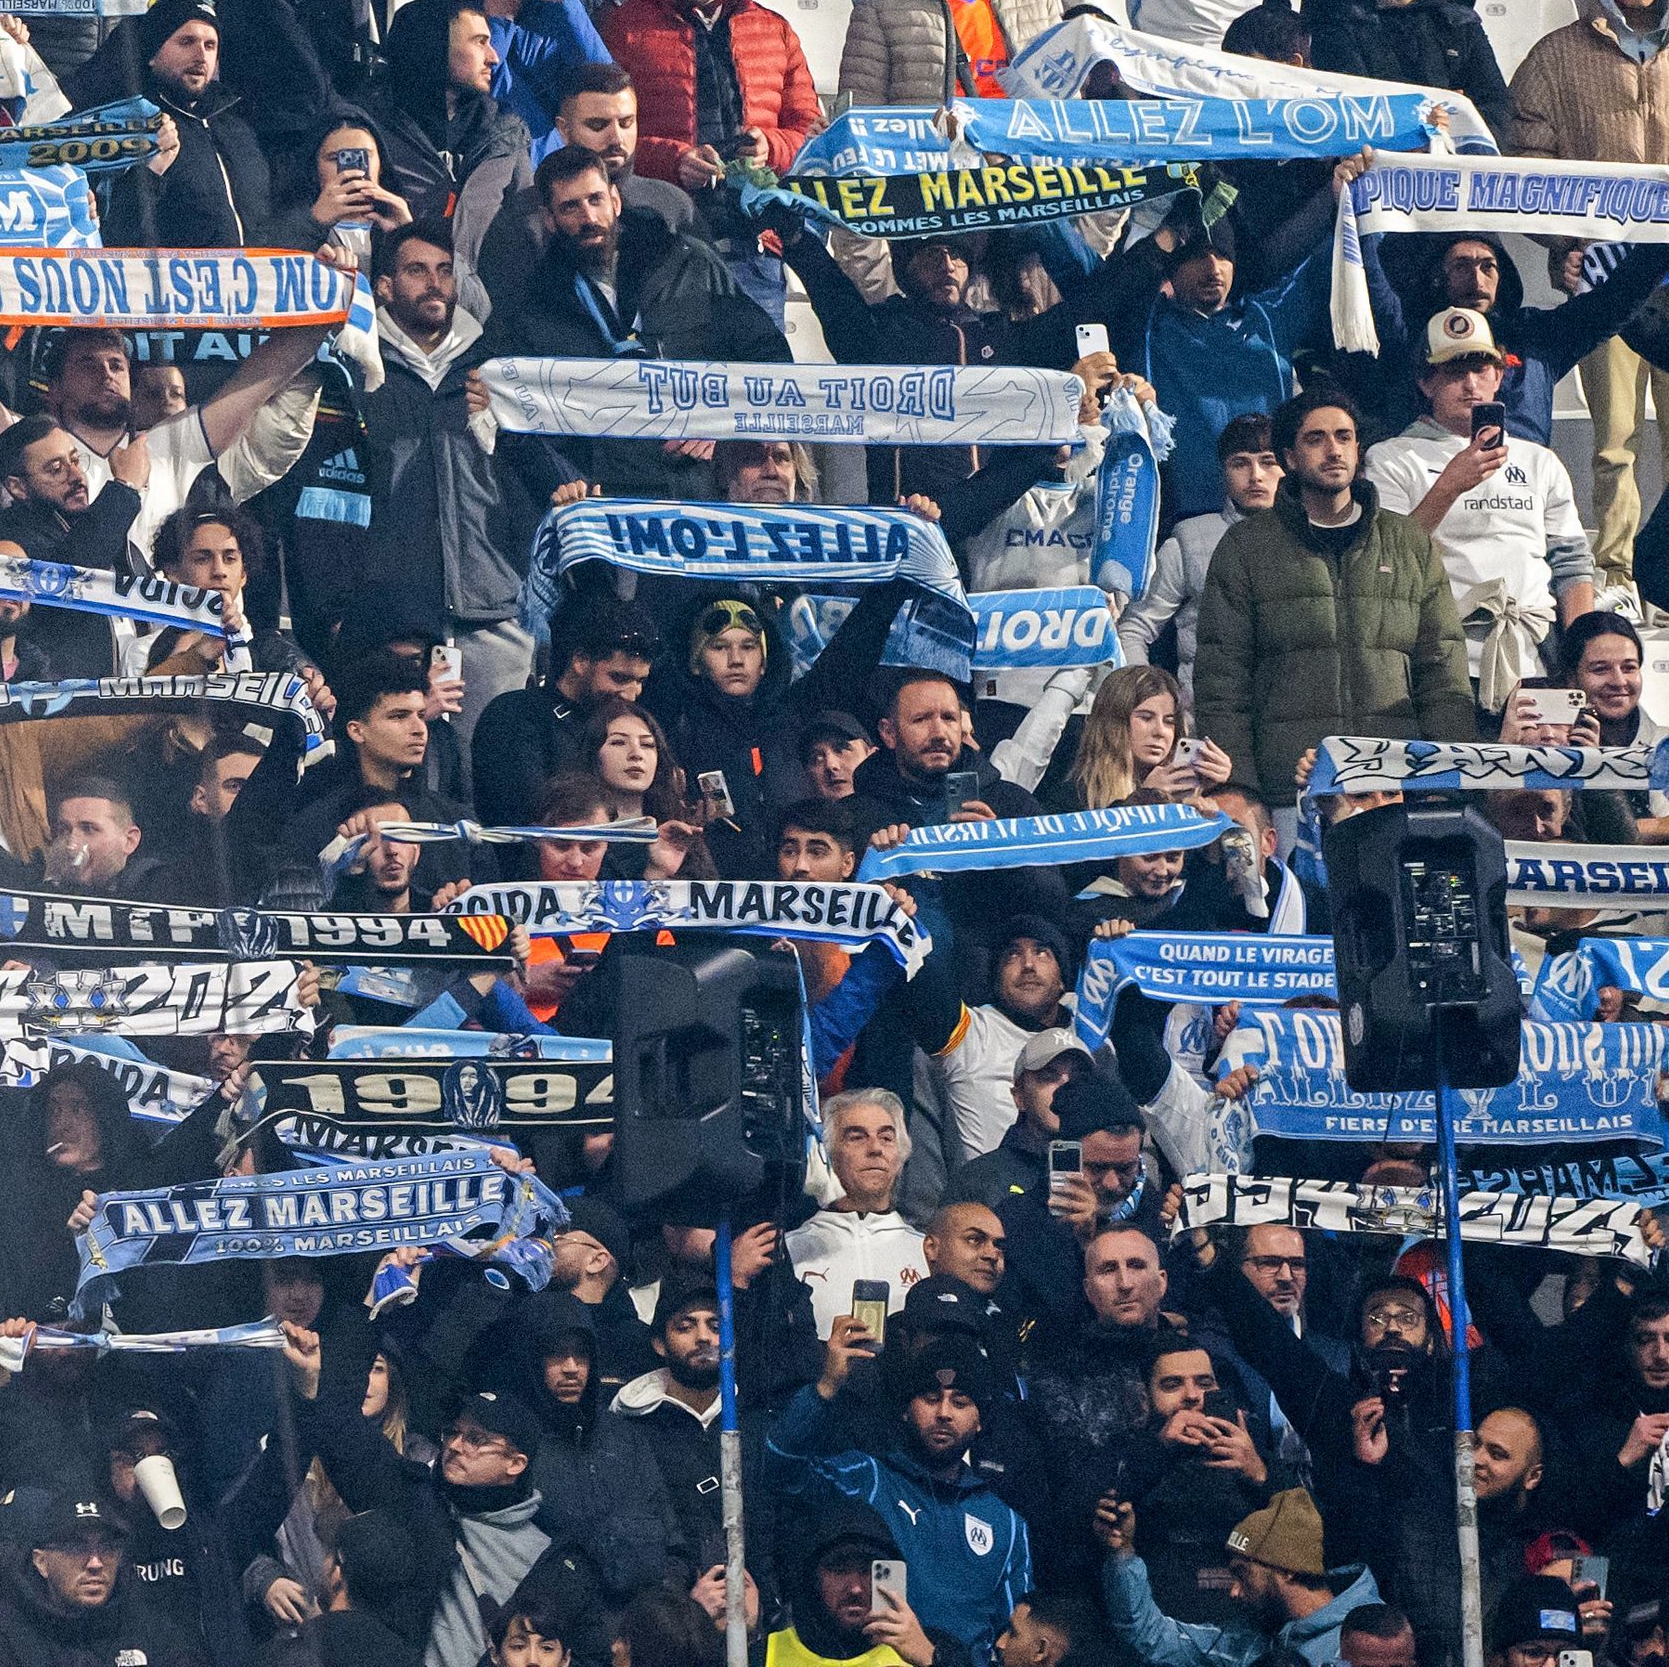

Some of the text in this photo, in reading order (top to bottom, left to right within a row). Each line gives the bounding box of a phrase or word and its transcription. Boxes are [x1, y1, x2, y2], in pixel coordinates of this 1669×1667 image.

[1008, 95, 1394, 143] ALLEZ L'OM
[30, 137, 158, 166] 2009
[921, 166, 1148, 215] MARSEILLE
[849, 187, 1145, 236] SOMMES LES MARSEILLAIS
[15, 256, 341, 314] OM C'EST NOUS
[318, 466, 366, 484] adidas
[1125, 451, 1145, 524] Orange
[1463, 495, 1535, 513] randstad
[283, 910, 450, 948] 1994
[1159, 944, 1334, 965] QUAND LE VIRAGE
[1134, 965, 1335, 989] C'EST TOUT LE STADE
[281, 1071, 441, 1117] 19
[1324, 1113, 1633, 1134] FIERS MARSEILLAIS
[291, 1156, 478, 1186] LES MARSEILLAIS
[124, 1176, 504, 1235] ALLEZ MARSEILLE
[215, 1214, 483, 1255] 100% MARSEILLAIS
